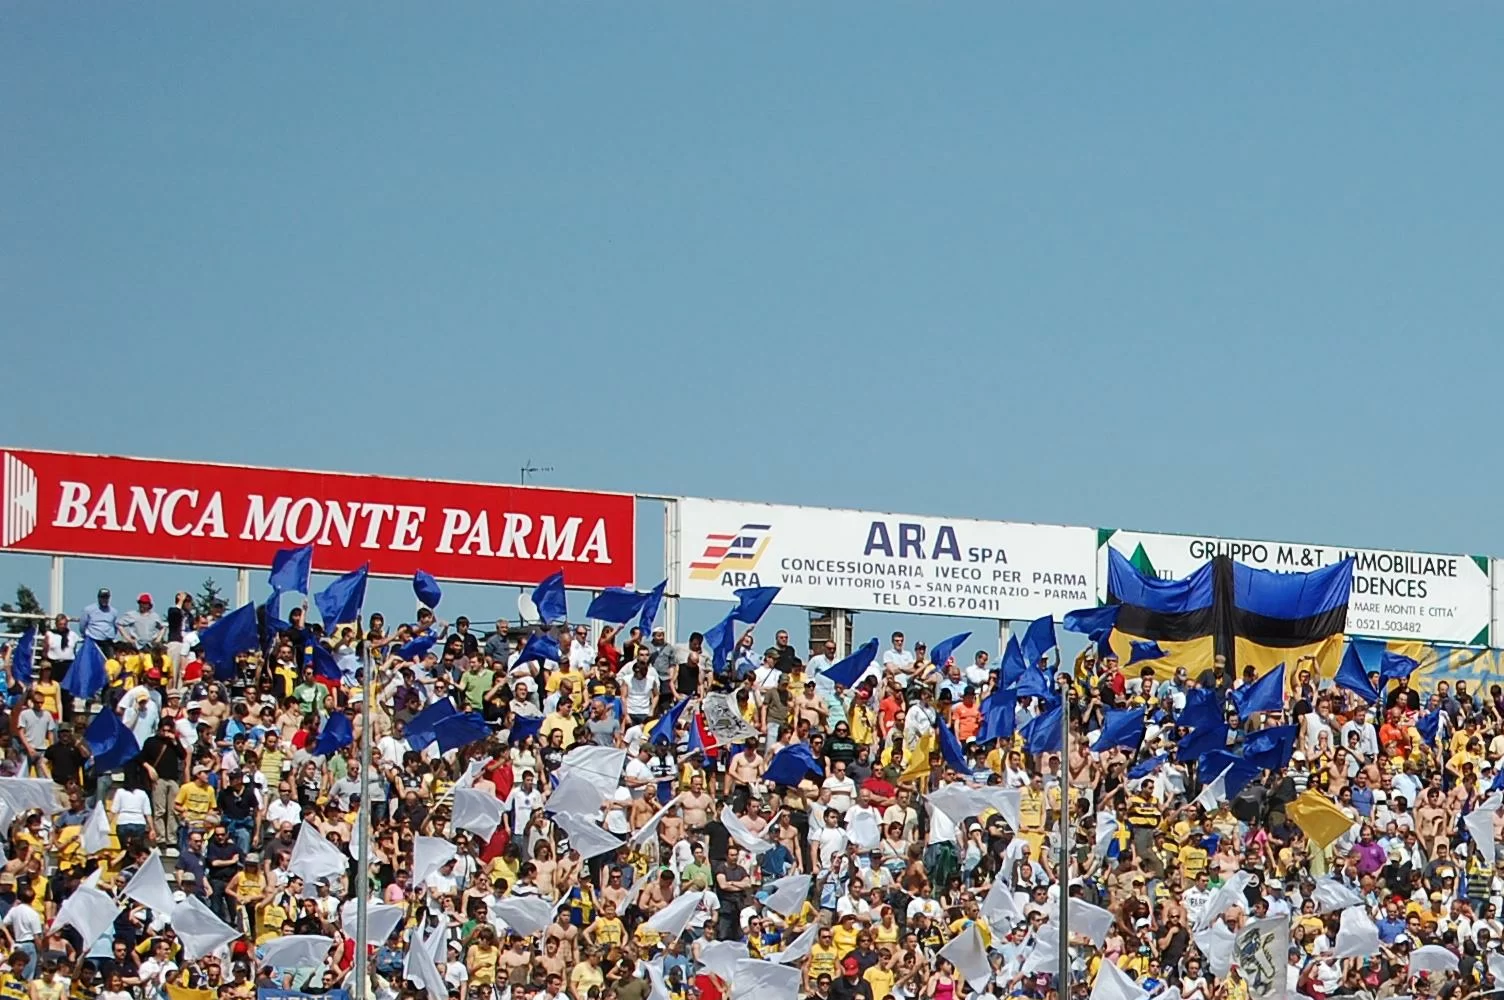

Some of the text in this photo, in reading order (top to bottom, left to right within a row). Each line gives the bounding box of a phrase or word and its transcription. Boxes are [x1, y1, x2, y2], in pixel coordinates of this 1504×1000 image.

[52, 480, 613, 565] BANCA MONTE PARMA
[863, 521, 1009, 565] ARA SPA
[1190, 540, 1268, 563] GRUPPO
[721, 571, 761, 588] ARA
[781, 557, 1087, 587] CONCESSIONARIA IVECO PER PARMA
[781, 573, 804, 585] VIA
[808, 575, 821, 586] DI
[825, 575, 884, 590] VITTORIO
[890, 579, 911, 591] 15A
[927, 580, 952, 593] SAN
[956, 582, 1029, 598] PANCRAZIO
[1044, 587, 1087, 601] PARMA
[1351, 576, 1427, 598] IDENCES
[873, 592, 1000, 611] TEL 0521.670411
[1354, 602, 1380, 614] MARE
[1384, 604, 1416, 616] MONTI
[1420, 606, 1425, 616] E
[1356, 618, 1421, 632] 0521.503482
